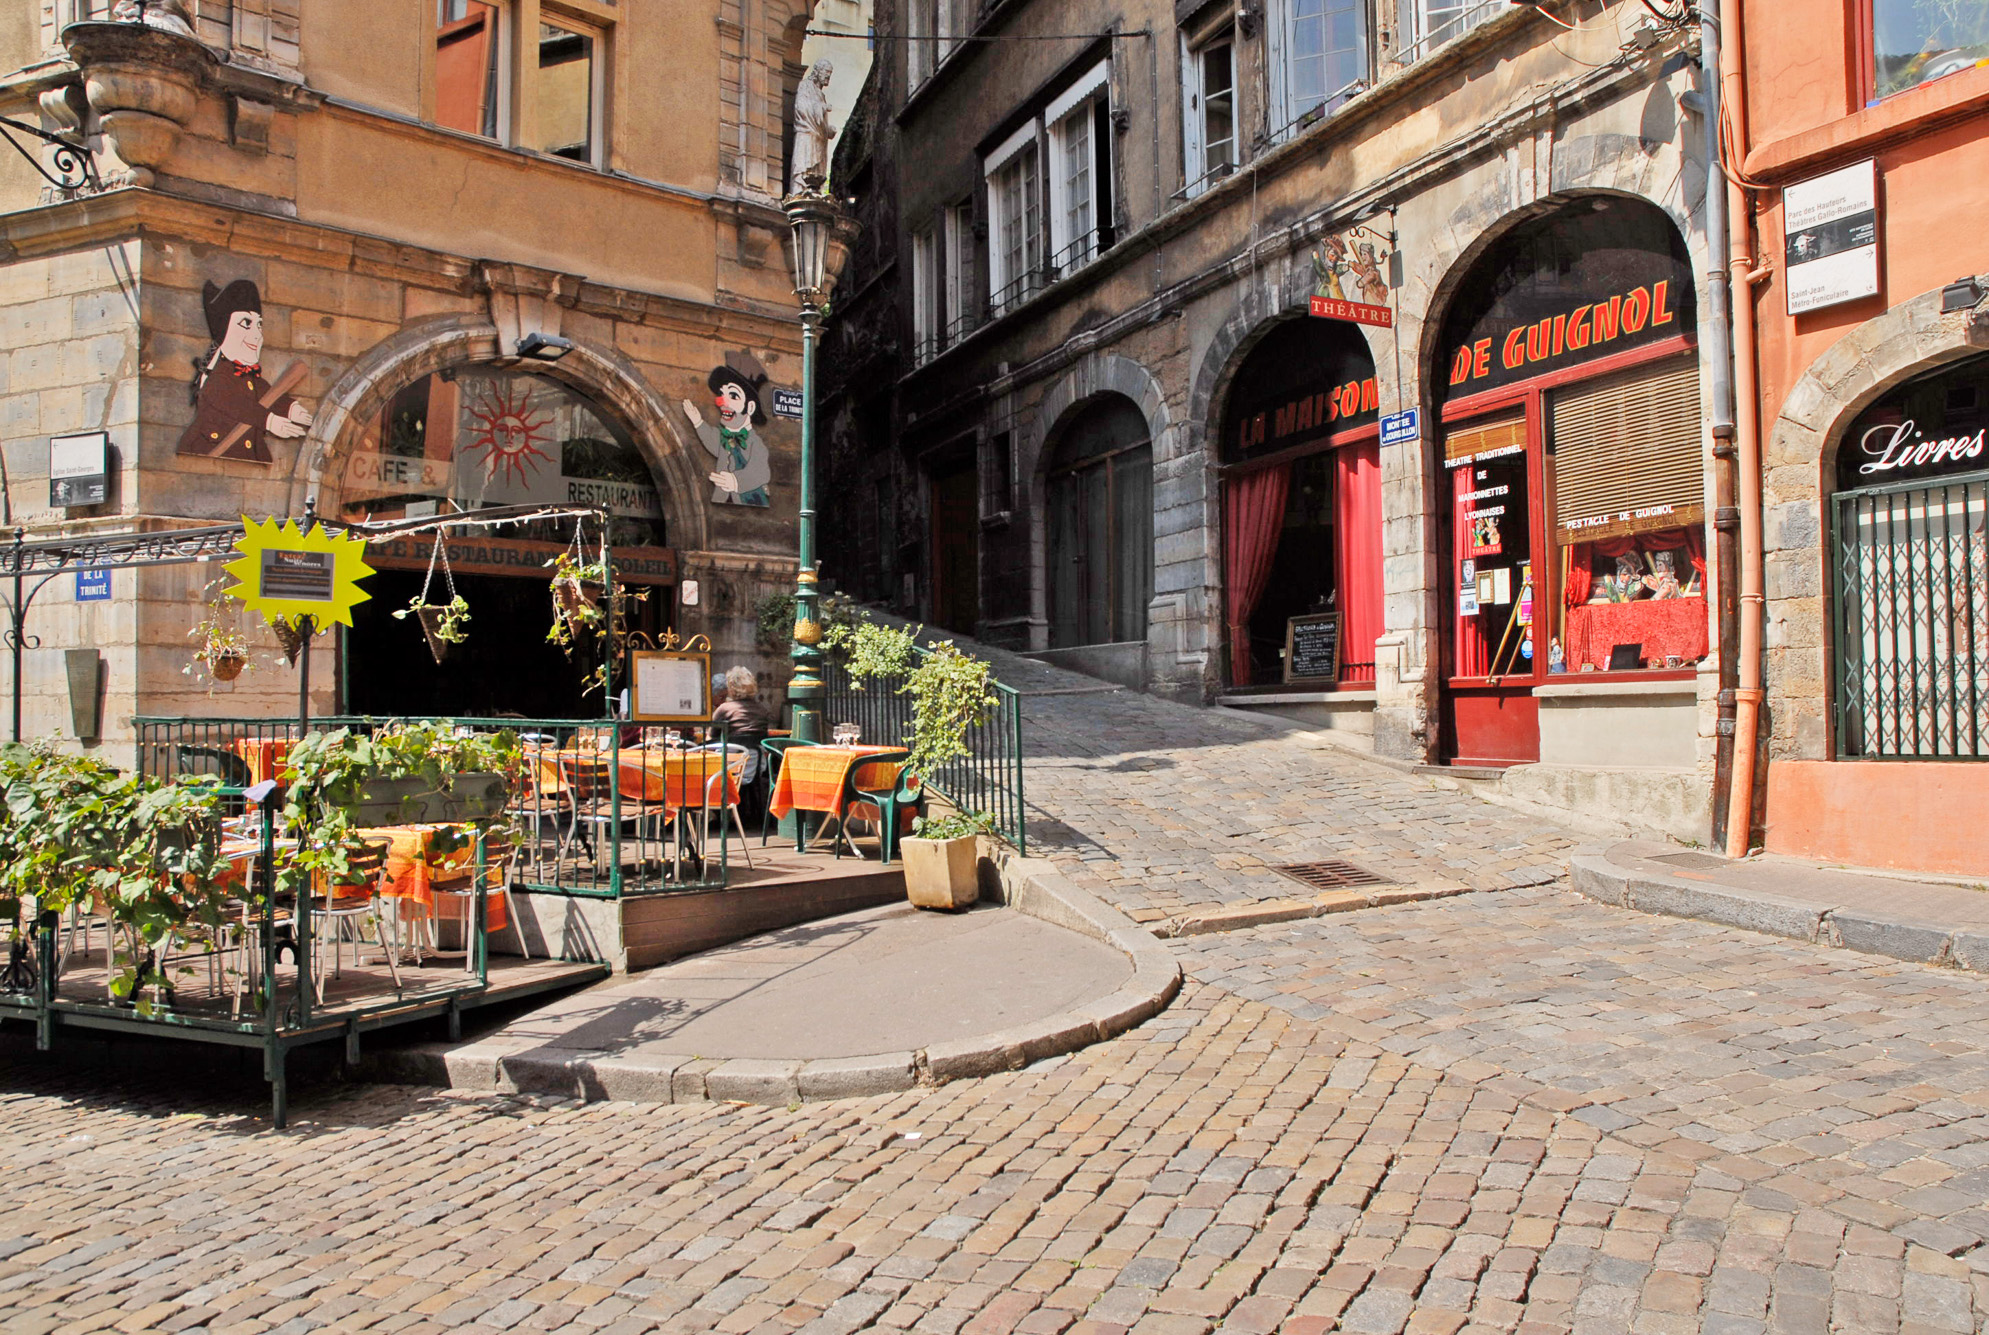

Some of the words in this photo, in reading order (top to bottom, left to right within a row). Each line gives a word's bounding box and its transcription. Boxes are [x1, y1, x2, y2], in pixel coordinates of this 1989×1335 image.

[1788, 210, 1802, 219] Parc
[1804, 206, 1815, 215] des
[1816, 197, 1847, 211] Hauteurs
[1817, 200, 1868, 221] Gallo-Romains
[1791, 285, 1825, 300] Saint-Jean
[1311, 300, 1390, 323] THÉÂTRE
[1449, 337, 1492, 386] DE
[1502, 280, 1674, 370] GUIGNOL
[775, 404, 781, 412] DE
[780, 396, 802, 406] PLACE
[1239, 411, 1265, 449] LA
[1275, 374, 1379, 439] MAISON
[1444, 455, 1473, 468] THEATRE
[1475, 444, 1522, 461] TRADITIONNEL
[1859, 420, 1986, 475] Livres
[1477, 470, 1487, 480] DE
[421, 465, 437, 486] &
[568, 482, 654, 511] RESTAURANT
[1458, 485, 1509, 502] MARIONNETTES
[1464, 505, 1505, 520] LYONNAISES
[1566, 514, 1610, 530] PESTACLE
[1619, 511, 1631, 521] DE
[1636, 504, 1675, 518] GUIGNOL
[414, 542, 560, 569] RSTAURAN
[83, 570, 93, 580] DE
[94, 570, 104, 579] LA
[80, 582, 108, 596] TRINITÉ
